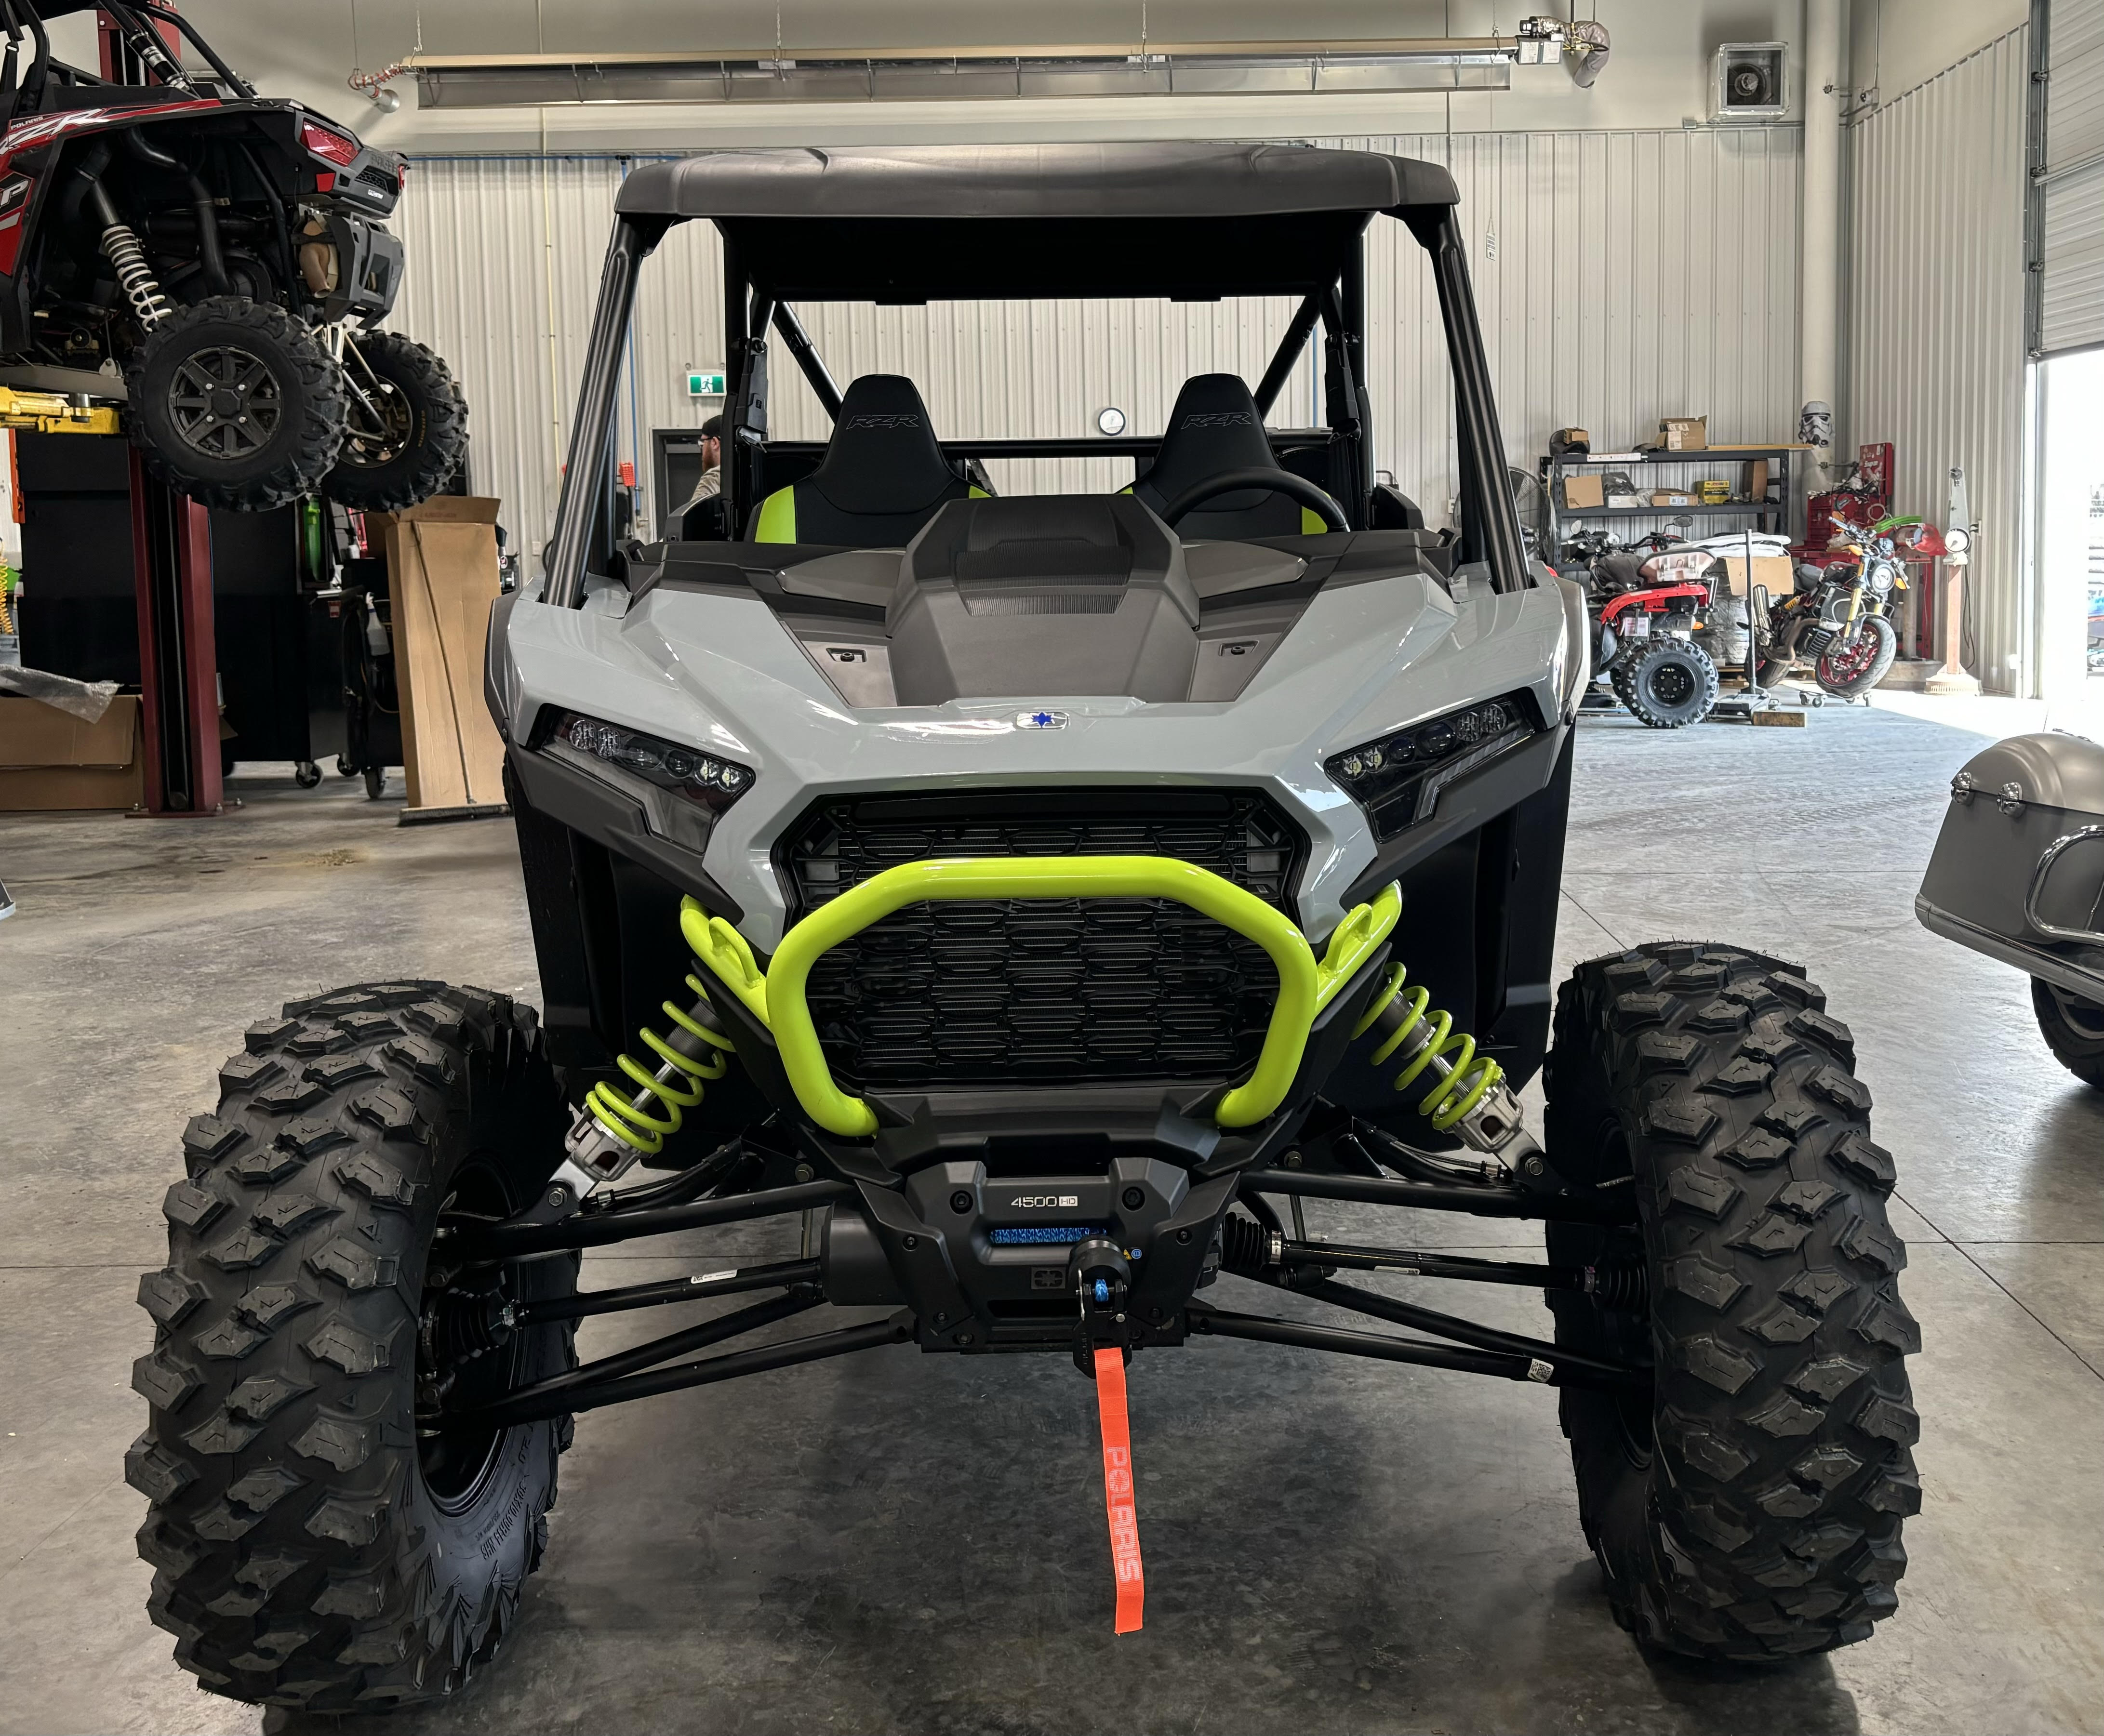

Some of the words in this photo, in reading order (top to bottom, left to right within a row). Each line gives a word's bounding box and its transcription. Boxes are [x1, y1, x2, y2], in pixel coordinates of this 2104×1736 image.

[11, 116, 44, 131] POLARIS
[846, 414, 919, 430] RZR
[1181, 412, 1252, 430] RZR
[1011, 1196, 1057, 1207] 4500
[1060, 1197, 1077, 1205] HD
[1107, 1446, 1140, 1582] POLARIS
